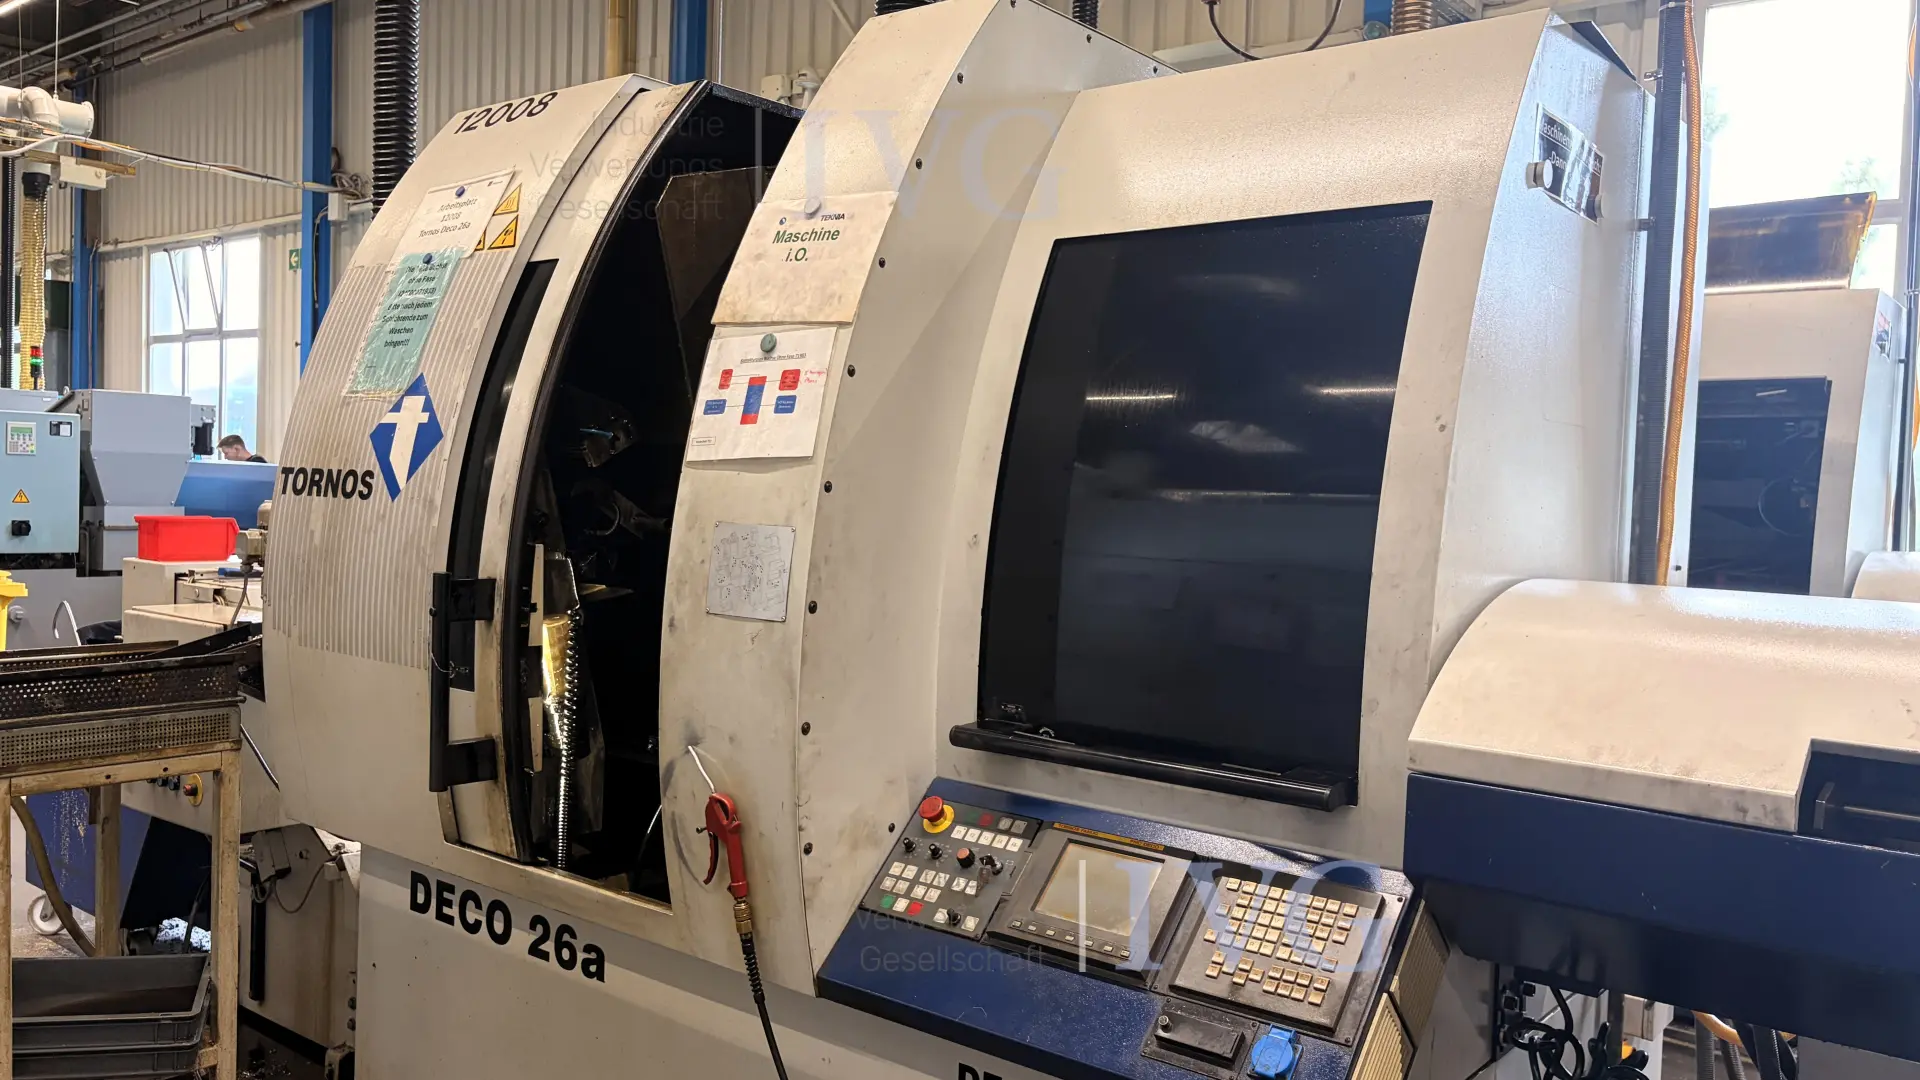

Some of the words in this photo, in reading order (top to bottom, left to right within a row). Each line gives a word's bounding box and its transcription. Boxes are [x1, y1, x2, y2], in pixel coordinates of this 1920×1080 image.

[453, 92, 559, 135] 12008
[418, 229, 440, 238] Tornos
[772, 228, 840, 245] Maschine
[785, 248, 809, 262] i.O.
[280, 467, 374, 500] TORNOS
[410, 870, 512, 945] DECO
[528, 914, 605, 983] 26a
